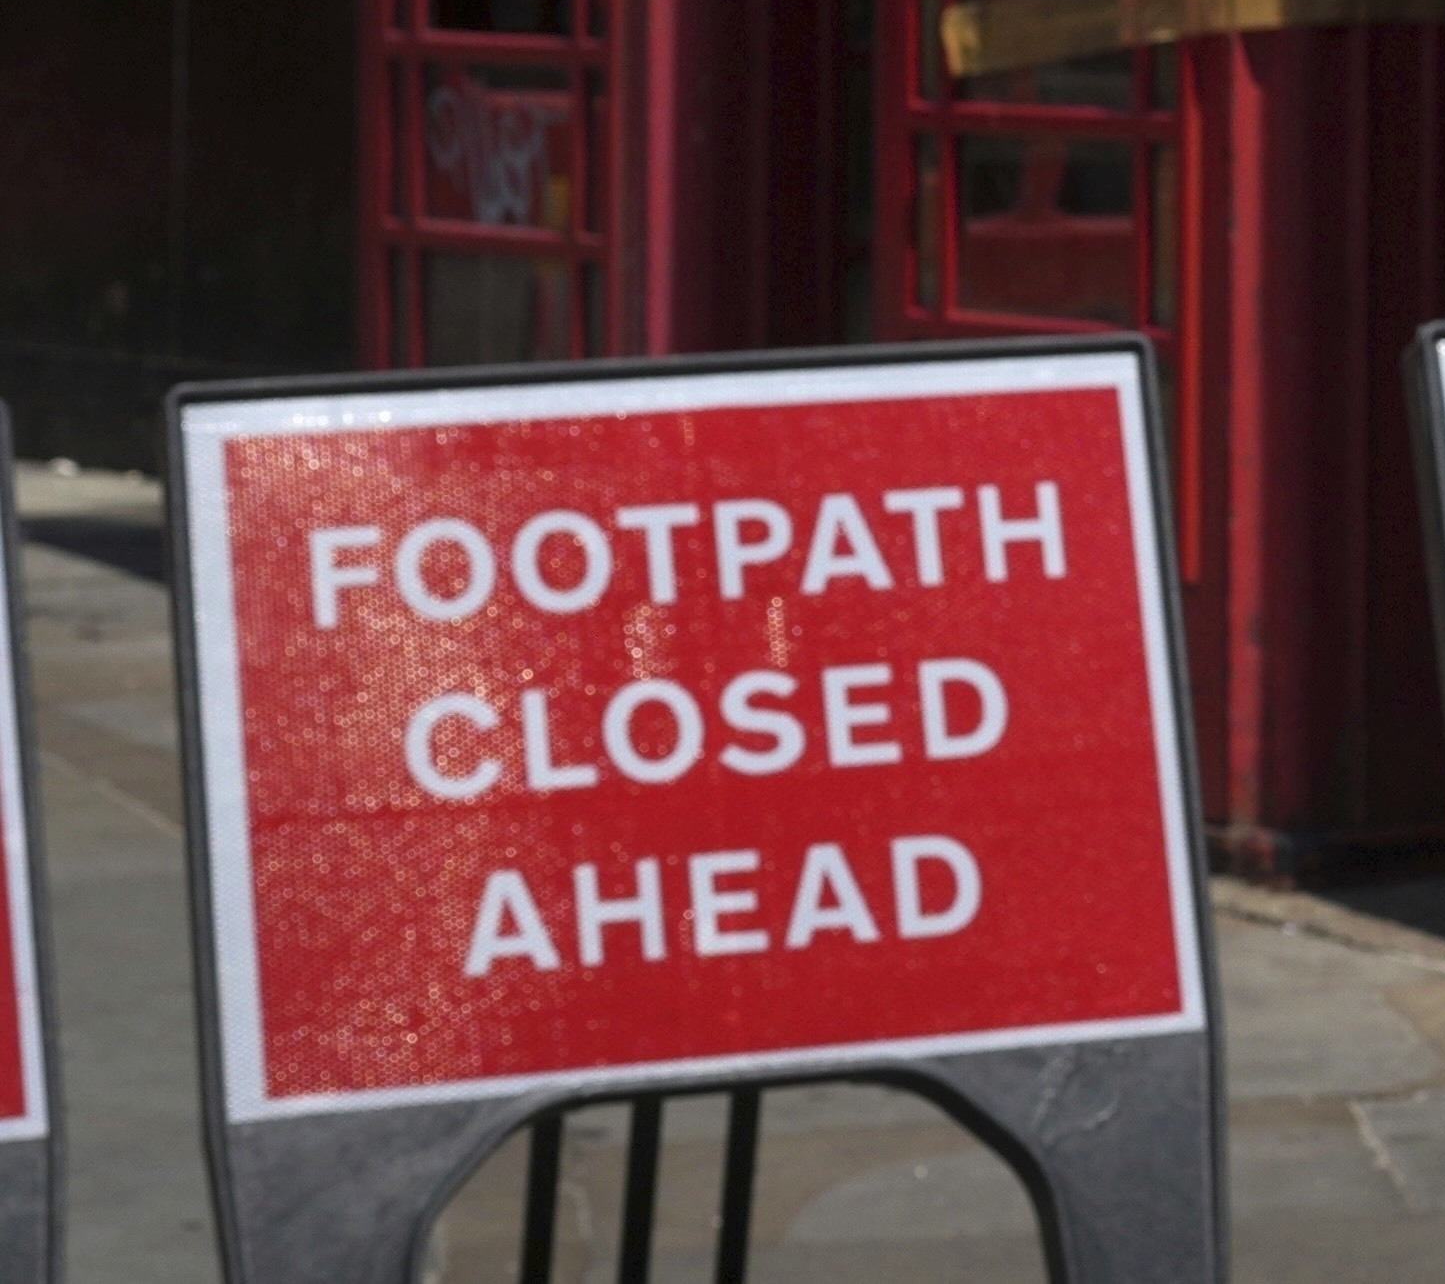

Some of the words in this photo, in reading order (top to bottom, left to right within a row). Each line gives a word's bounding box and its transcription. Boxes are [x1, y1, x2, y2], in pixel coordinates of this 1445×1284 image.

[306, 481, 1067, 630] FOOTPATH
[403, 659, 1008, 802] CLOSED
[462, 835, 983, 978] AHEAD
